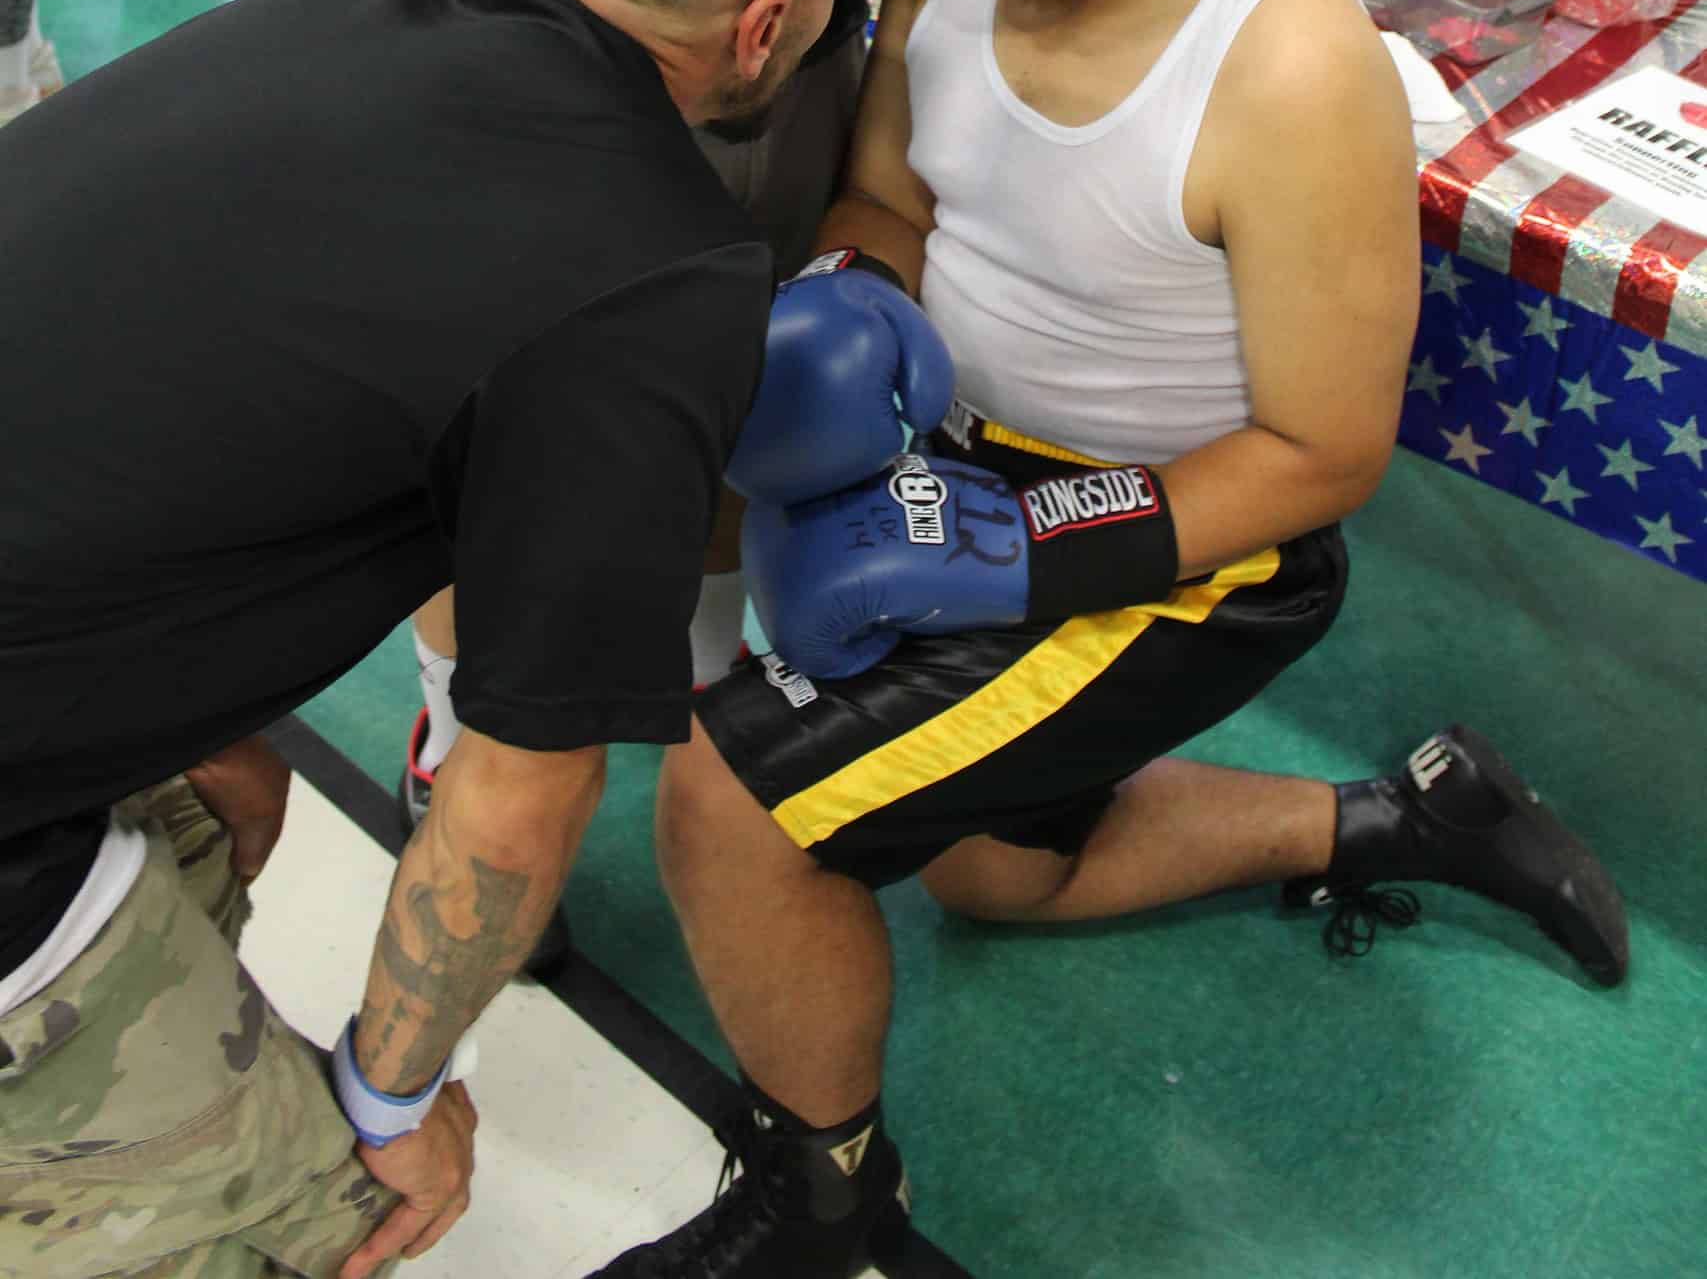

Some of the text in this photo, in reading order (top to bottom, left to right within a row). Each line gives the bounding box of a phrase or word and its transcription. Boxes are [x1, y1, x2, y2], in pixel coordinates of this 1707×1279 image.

[1598, 107, 1707, 169] RAFFL
[899, 477, 938, 501] R
[1024, 468, 1154, 533] RINGSIDE
